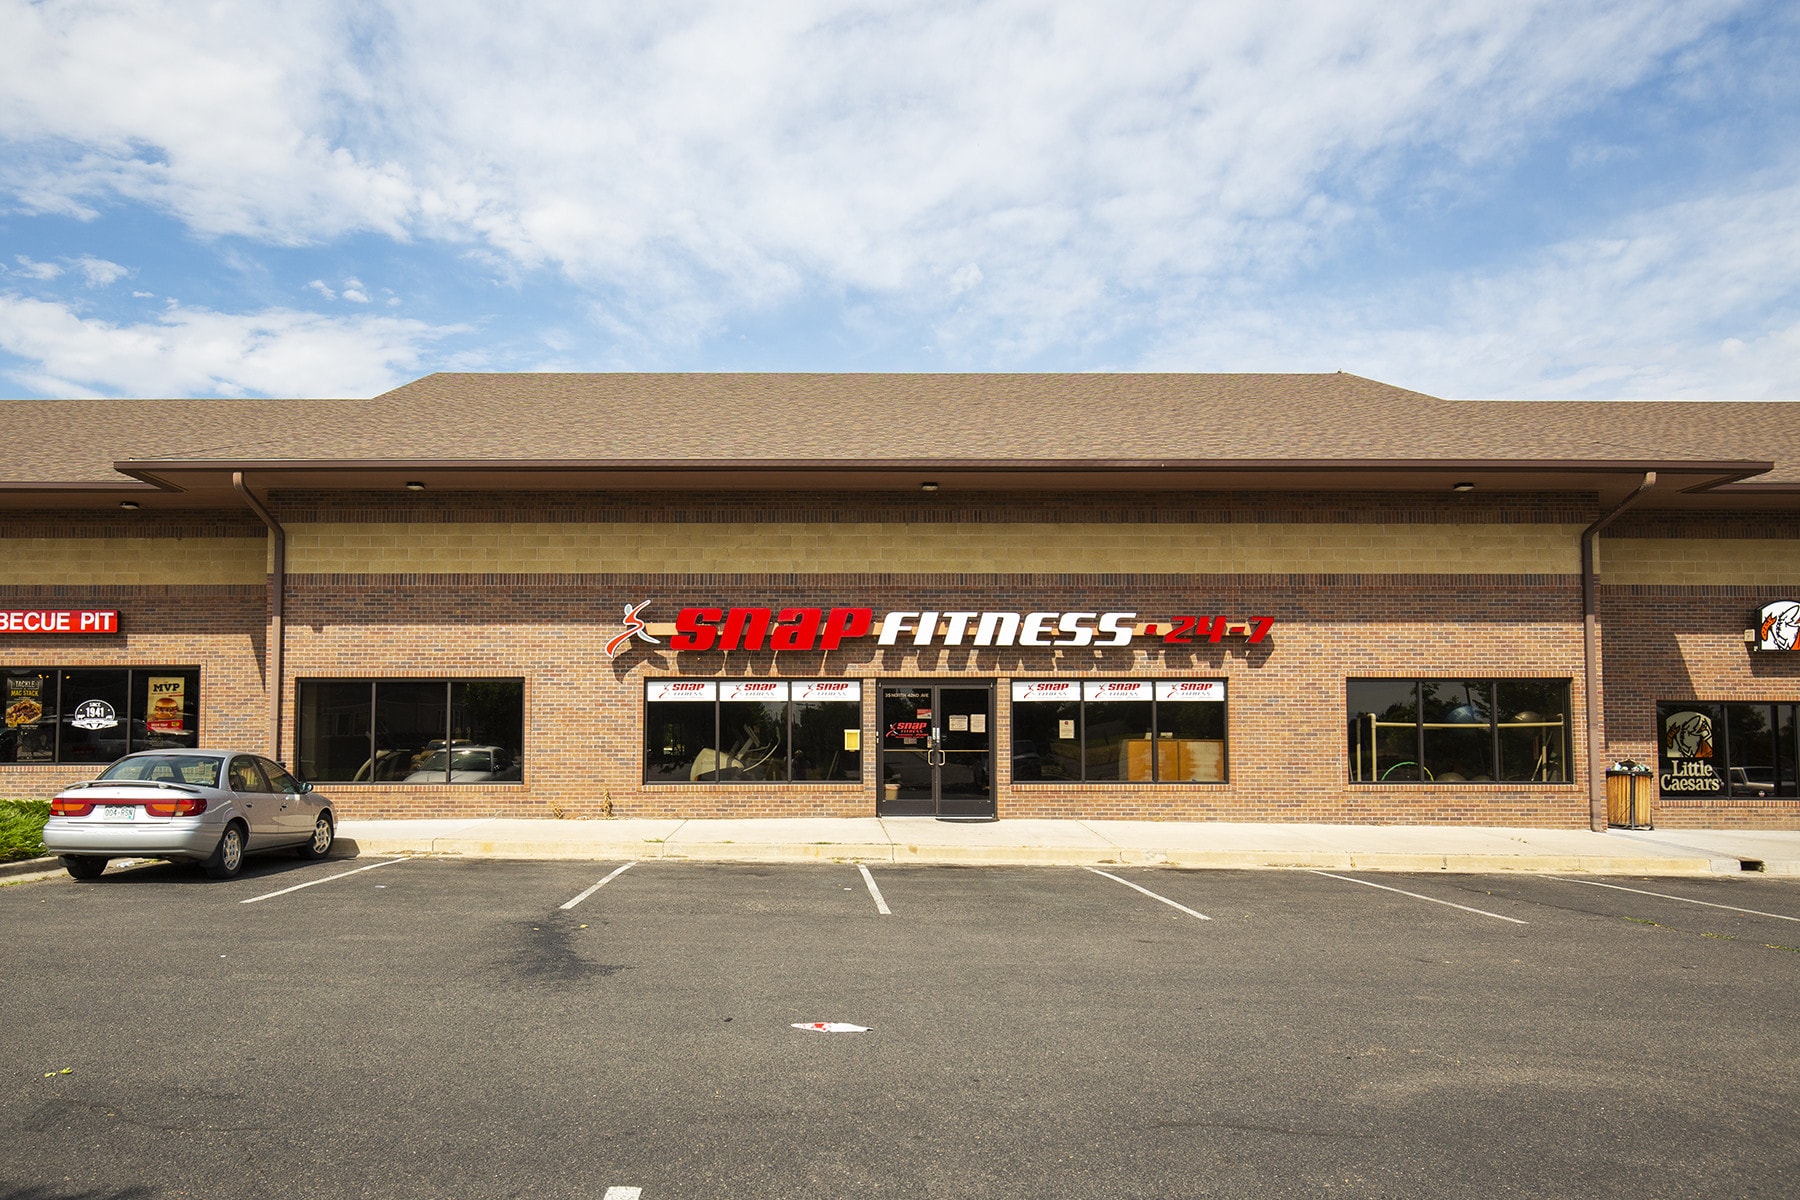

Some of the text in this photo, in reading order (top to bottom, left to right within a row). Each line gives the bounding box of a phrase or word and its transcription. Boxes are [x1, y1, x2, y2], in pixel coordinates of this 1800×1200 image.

[80, 612, 114, 631] PIT
[877, 611, 1137, 647] FITNESS
[153, 683, 180, 692] MVP
[86, 707, 104, 718] 1941
[1671, 760, 1713, 777] Little
[1660, 774, 1720, 791] Caesars
